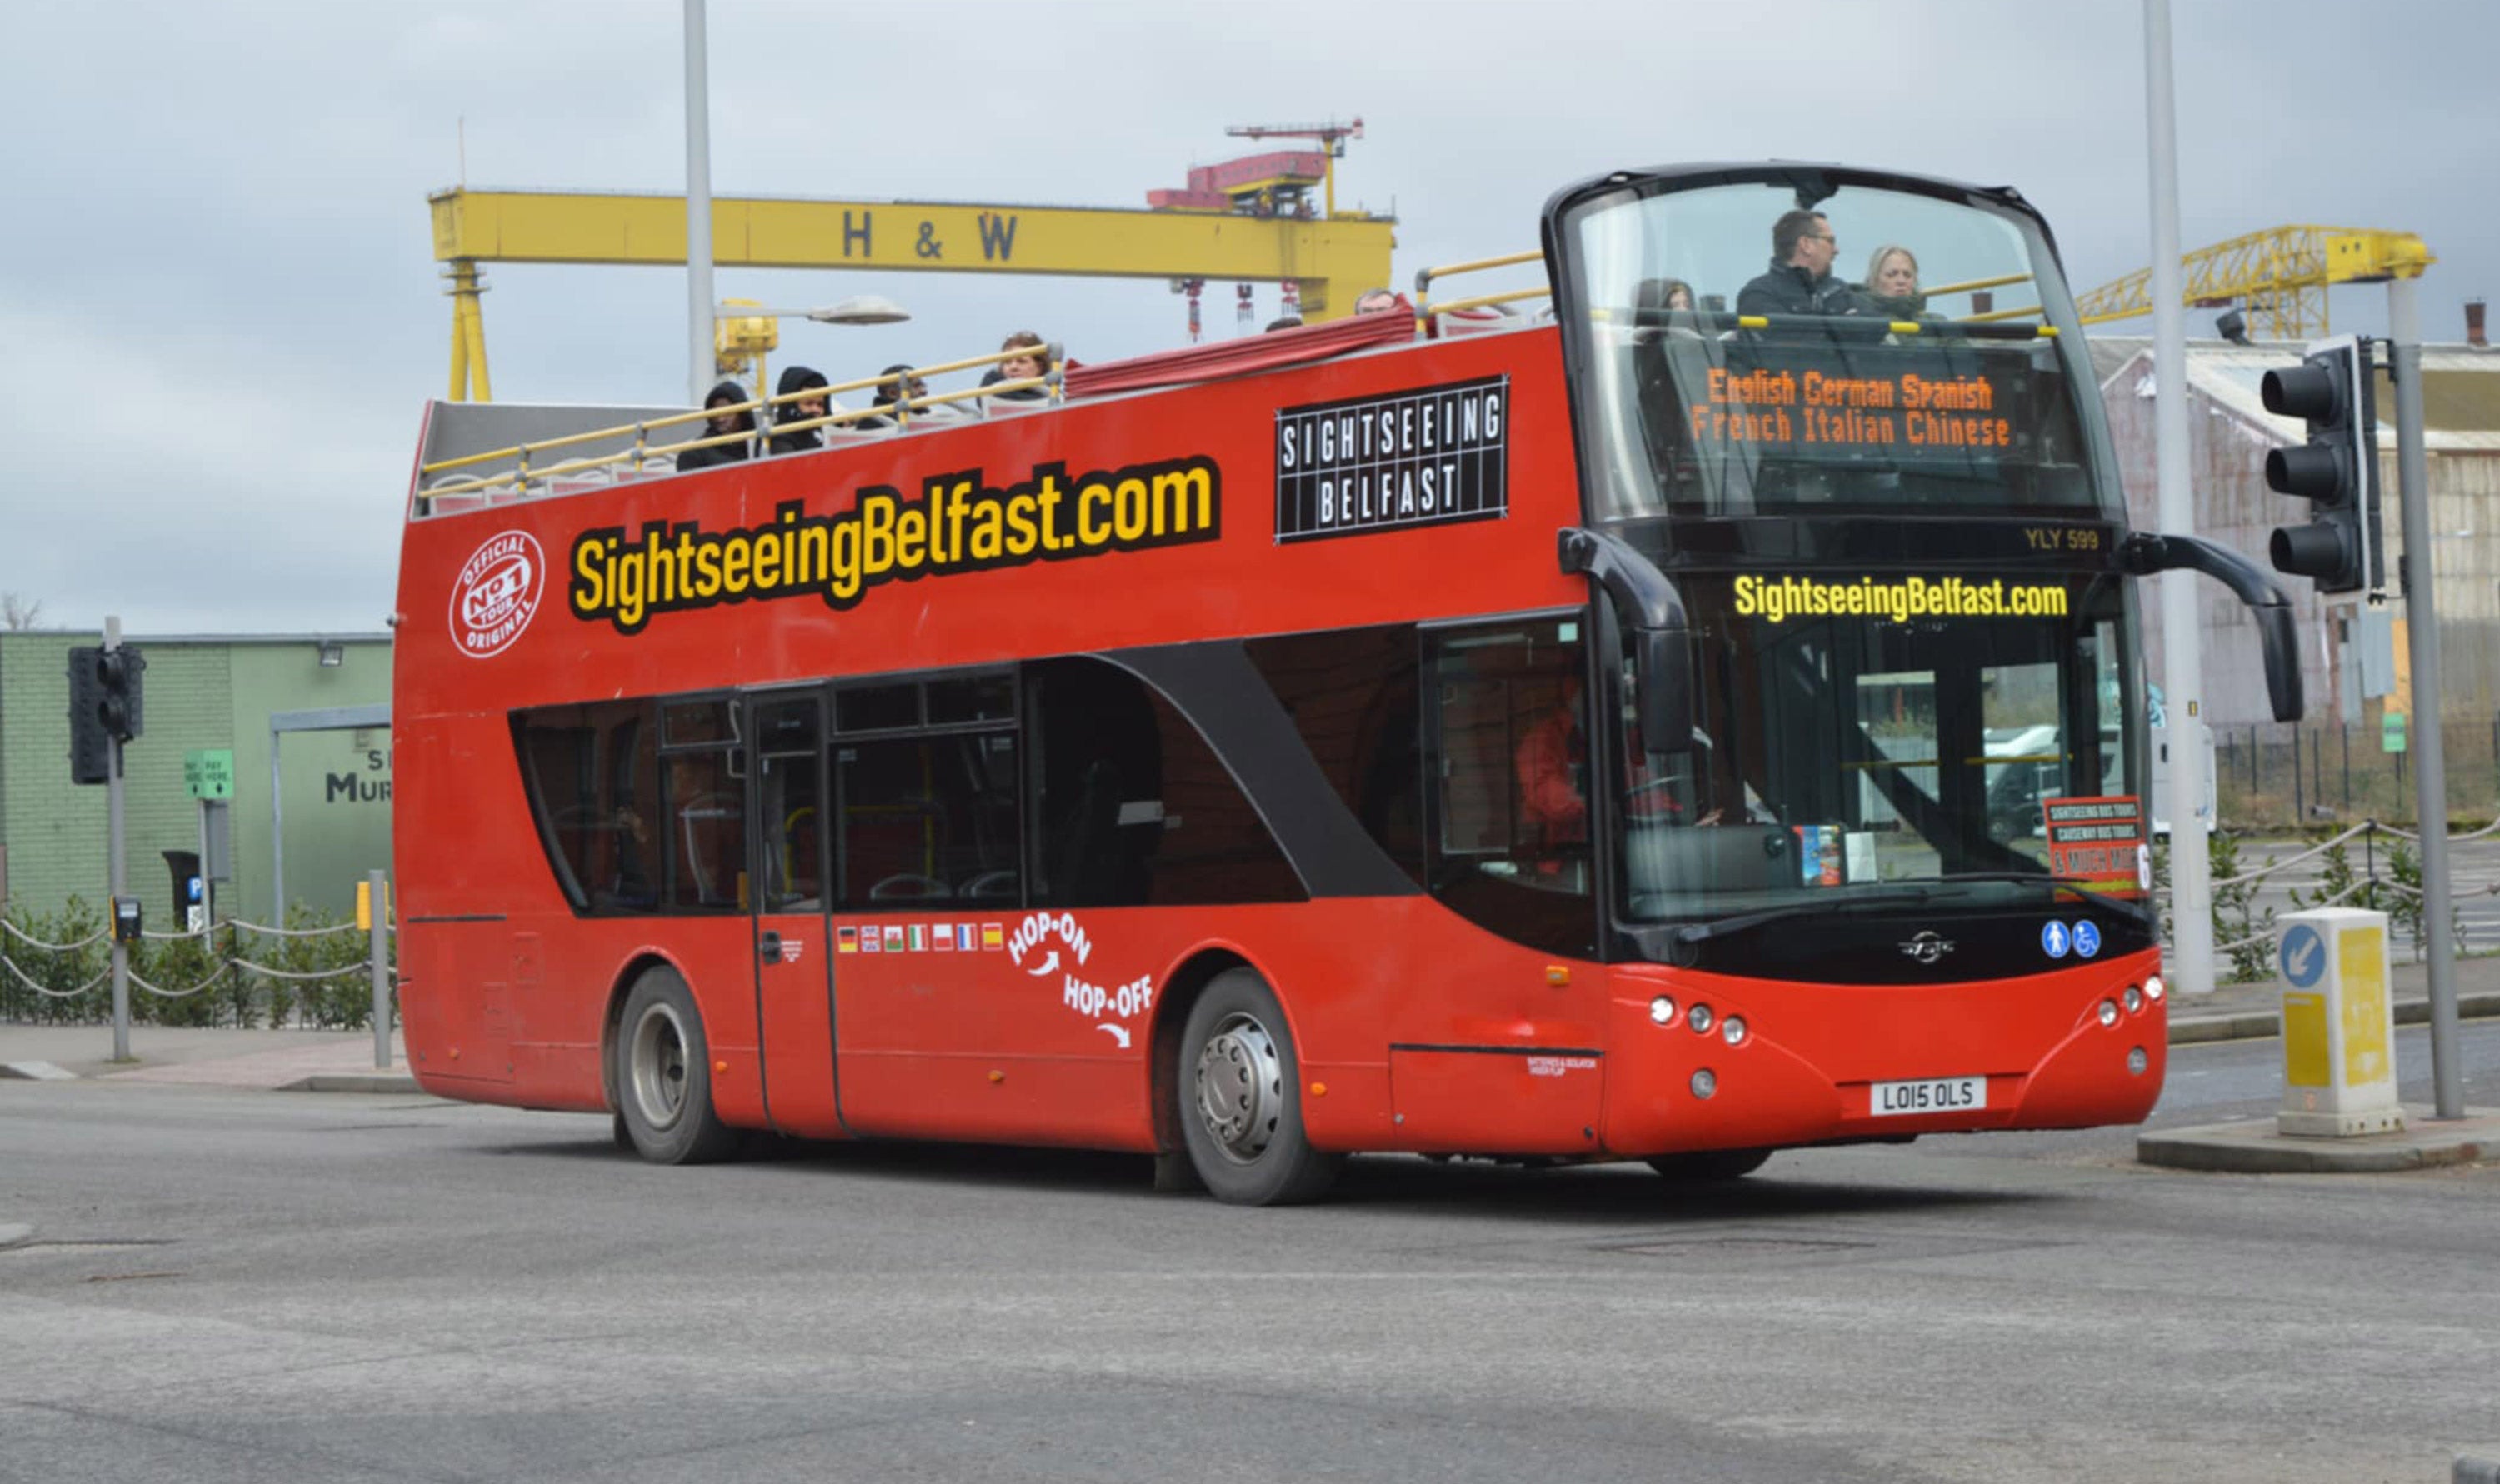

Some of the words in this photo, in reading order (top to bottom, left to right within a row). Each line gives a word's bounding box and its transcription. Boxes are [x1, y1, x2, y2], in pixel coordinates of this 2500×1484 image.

[842, 210, 872, 258] H
[915, 220, 942, 260] &
[977, 214, 1018, 262] W
[1708, 367, 1796, 406] English
[1803, 369, 1895, 407] German
[1901, 373, 1993, 411] Spanish
[1282, 393, 1500, 468] SIGHTSEEING
[1689, 405, 1792, 442] French
[1803, 407, 1895, 444] Italian
[1906, 410, 2010, 447] Chinese
[1320, 463, 1456, 524] BELFAST
[463, 536, 526, 585] OFFICIAL
[574, 466, 1212, 627] SightseeingBelfast.com
[2024, 528, 2062, 550] YLY
[2068, 528, 2098, 551] 599
[480, 597, 514, 625] TOUR
[1734, 575, 2068, 623] SightseeingBelfast.com
[467, 599, 532, 649] ORIGINAL
[368, 749, 392, 771] S
[1883, 1084, 1930, 1110] LO15
[1934, 1082, 1974, 1107] OLS
